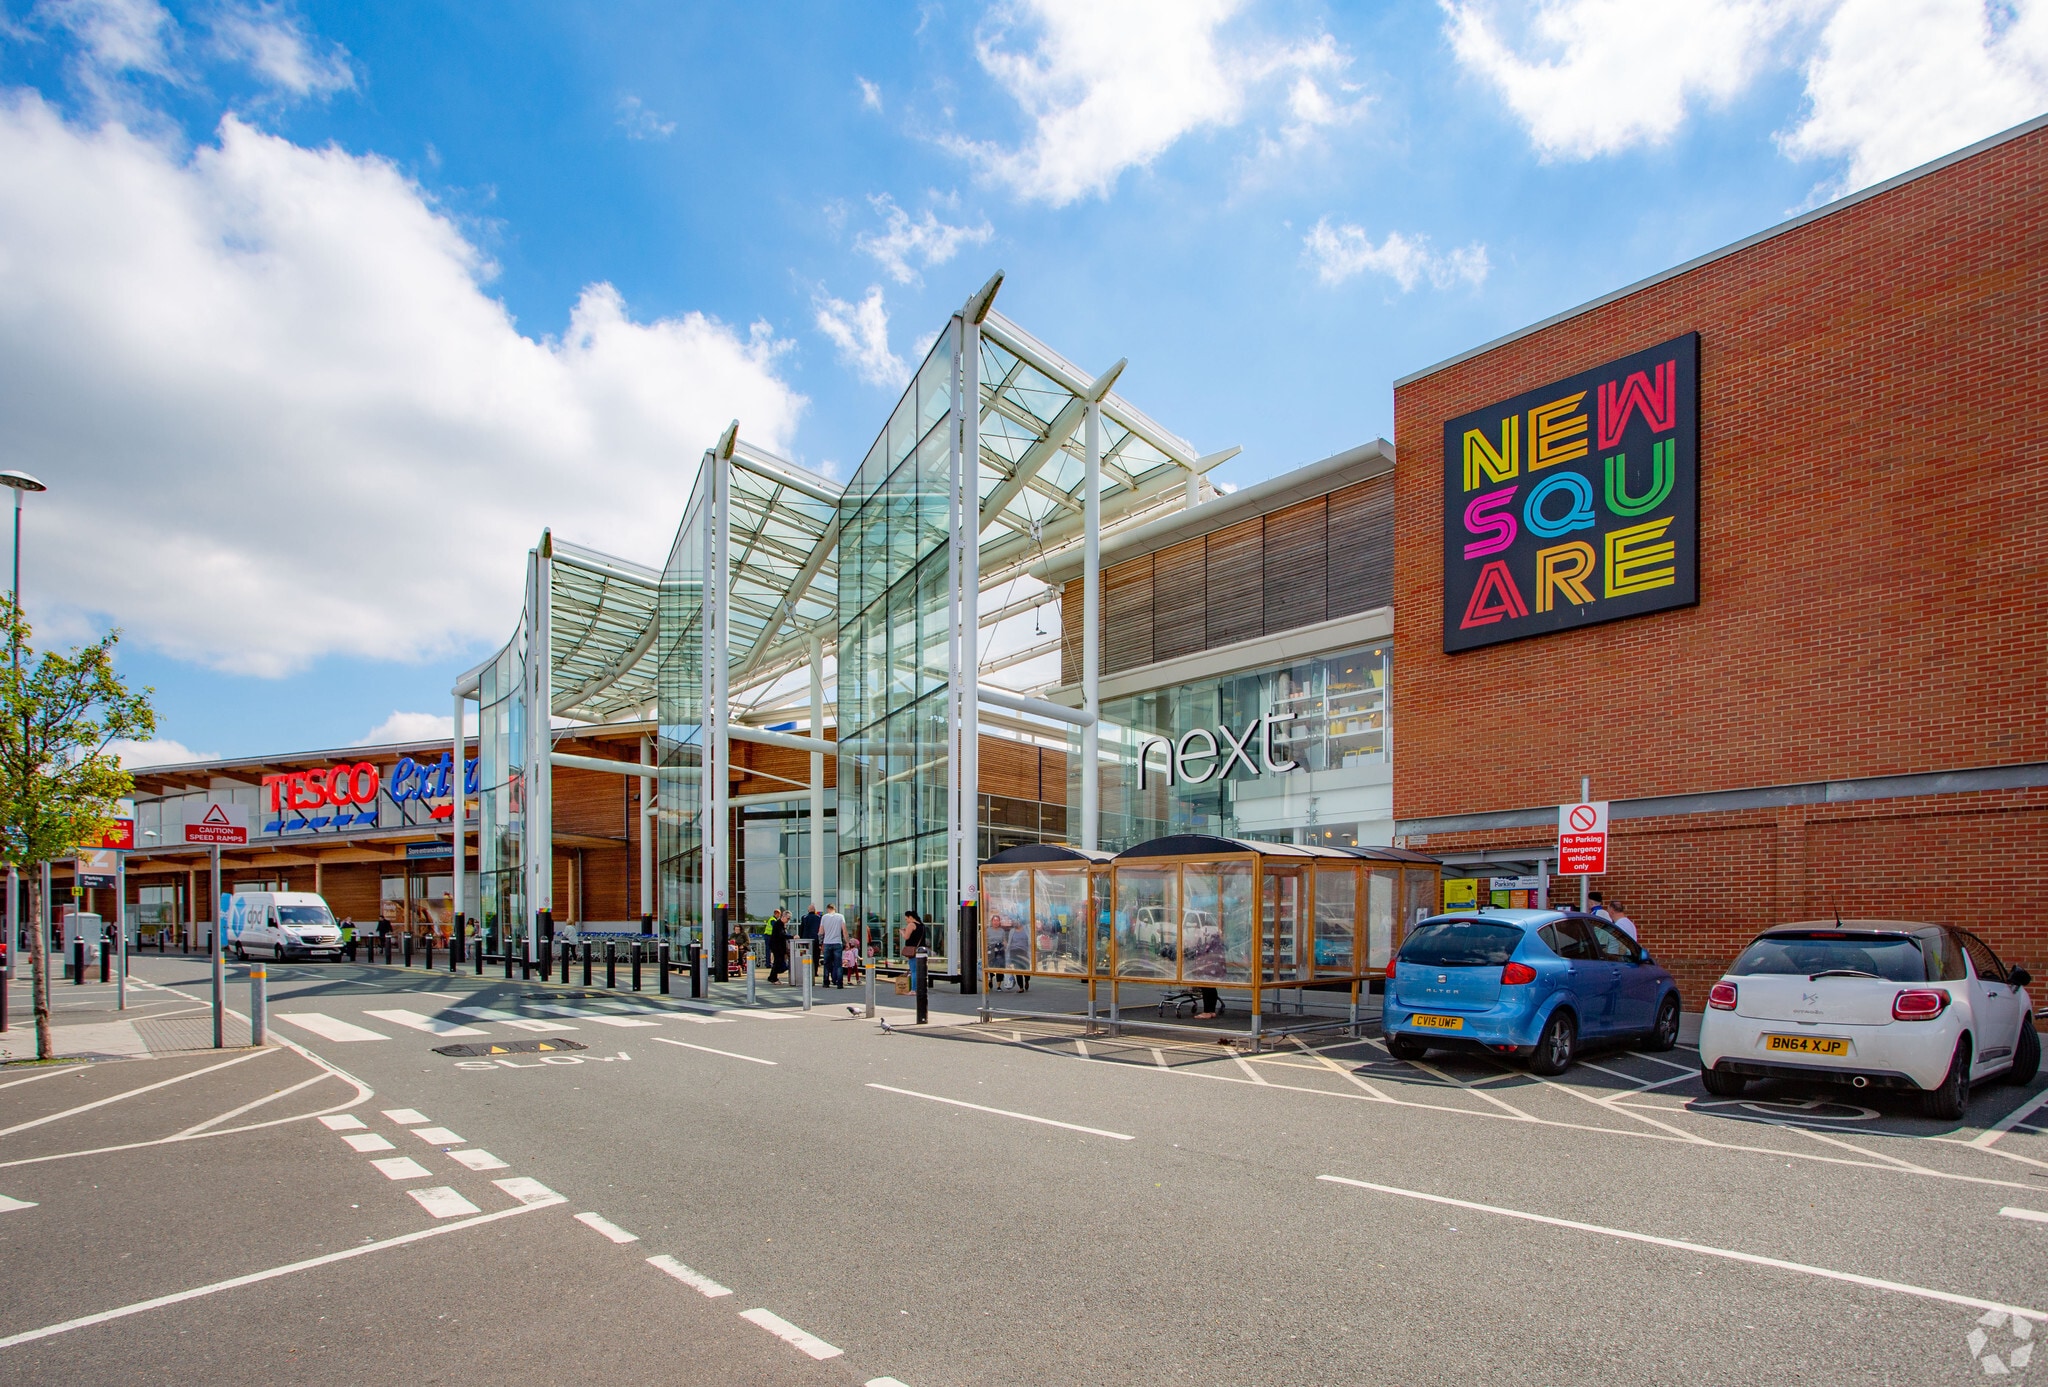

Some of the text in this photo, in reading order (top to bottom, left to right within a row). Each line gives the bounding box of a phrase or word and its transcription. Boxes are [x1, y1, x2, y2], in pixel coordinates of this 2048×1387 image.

[1463, 359, 1675, 492] NEW
[1463, 438, 1675, 560] SQU
[1459, 515, 1675, 630] ARE
[1137, 712, 1300, 790] next
[262, 762, 380, 812] TESCO
[199, 826, 234, 834] CAUTION
[1575, 836, 1602, 844] Parking
[1562, 846, 1602, 854] Emergency
[1573, 863, 1589, 871] only
[1494, 879, 1516, 889] Parking
[247, 905, 264, 929] dpd
[1416, 1016, 1458, 1028] CV15 UWF
[1772, 1037, 1842, 1053] BN64 XJP
[453, 1051, 632, 1070] SLOW
